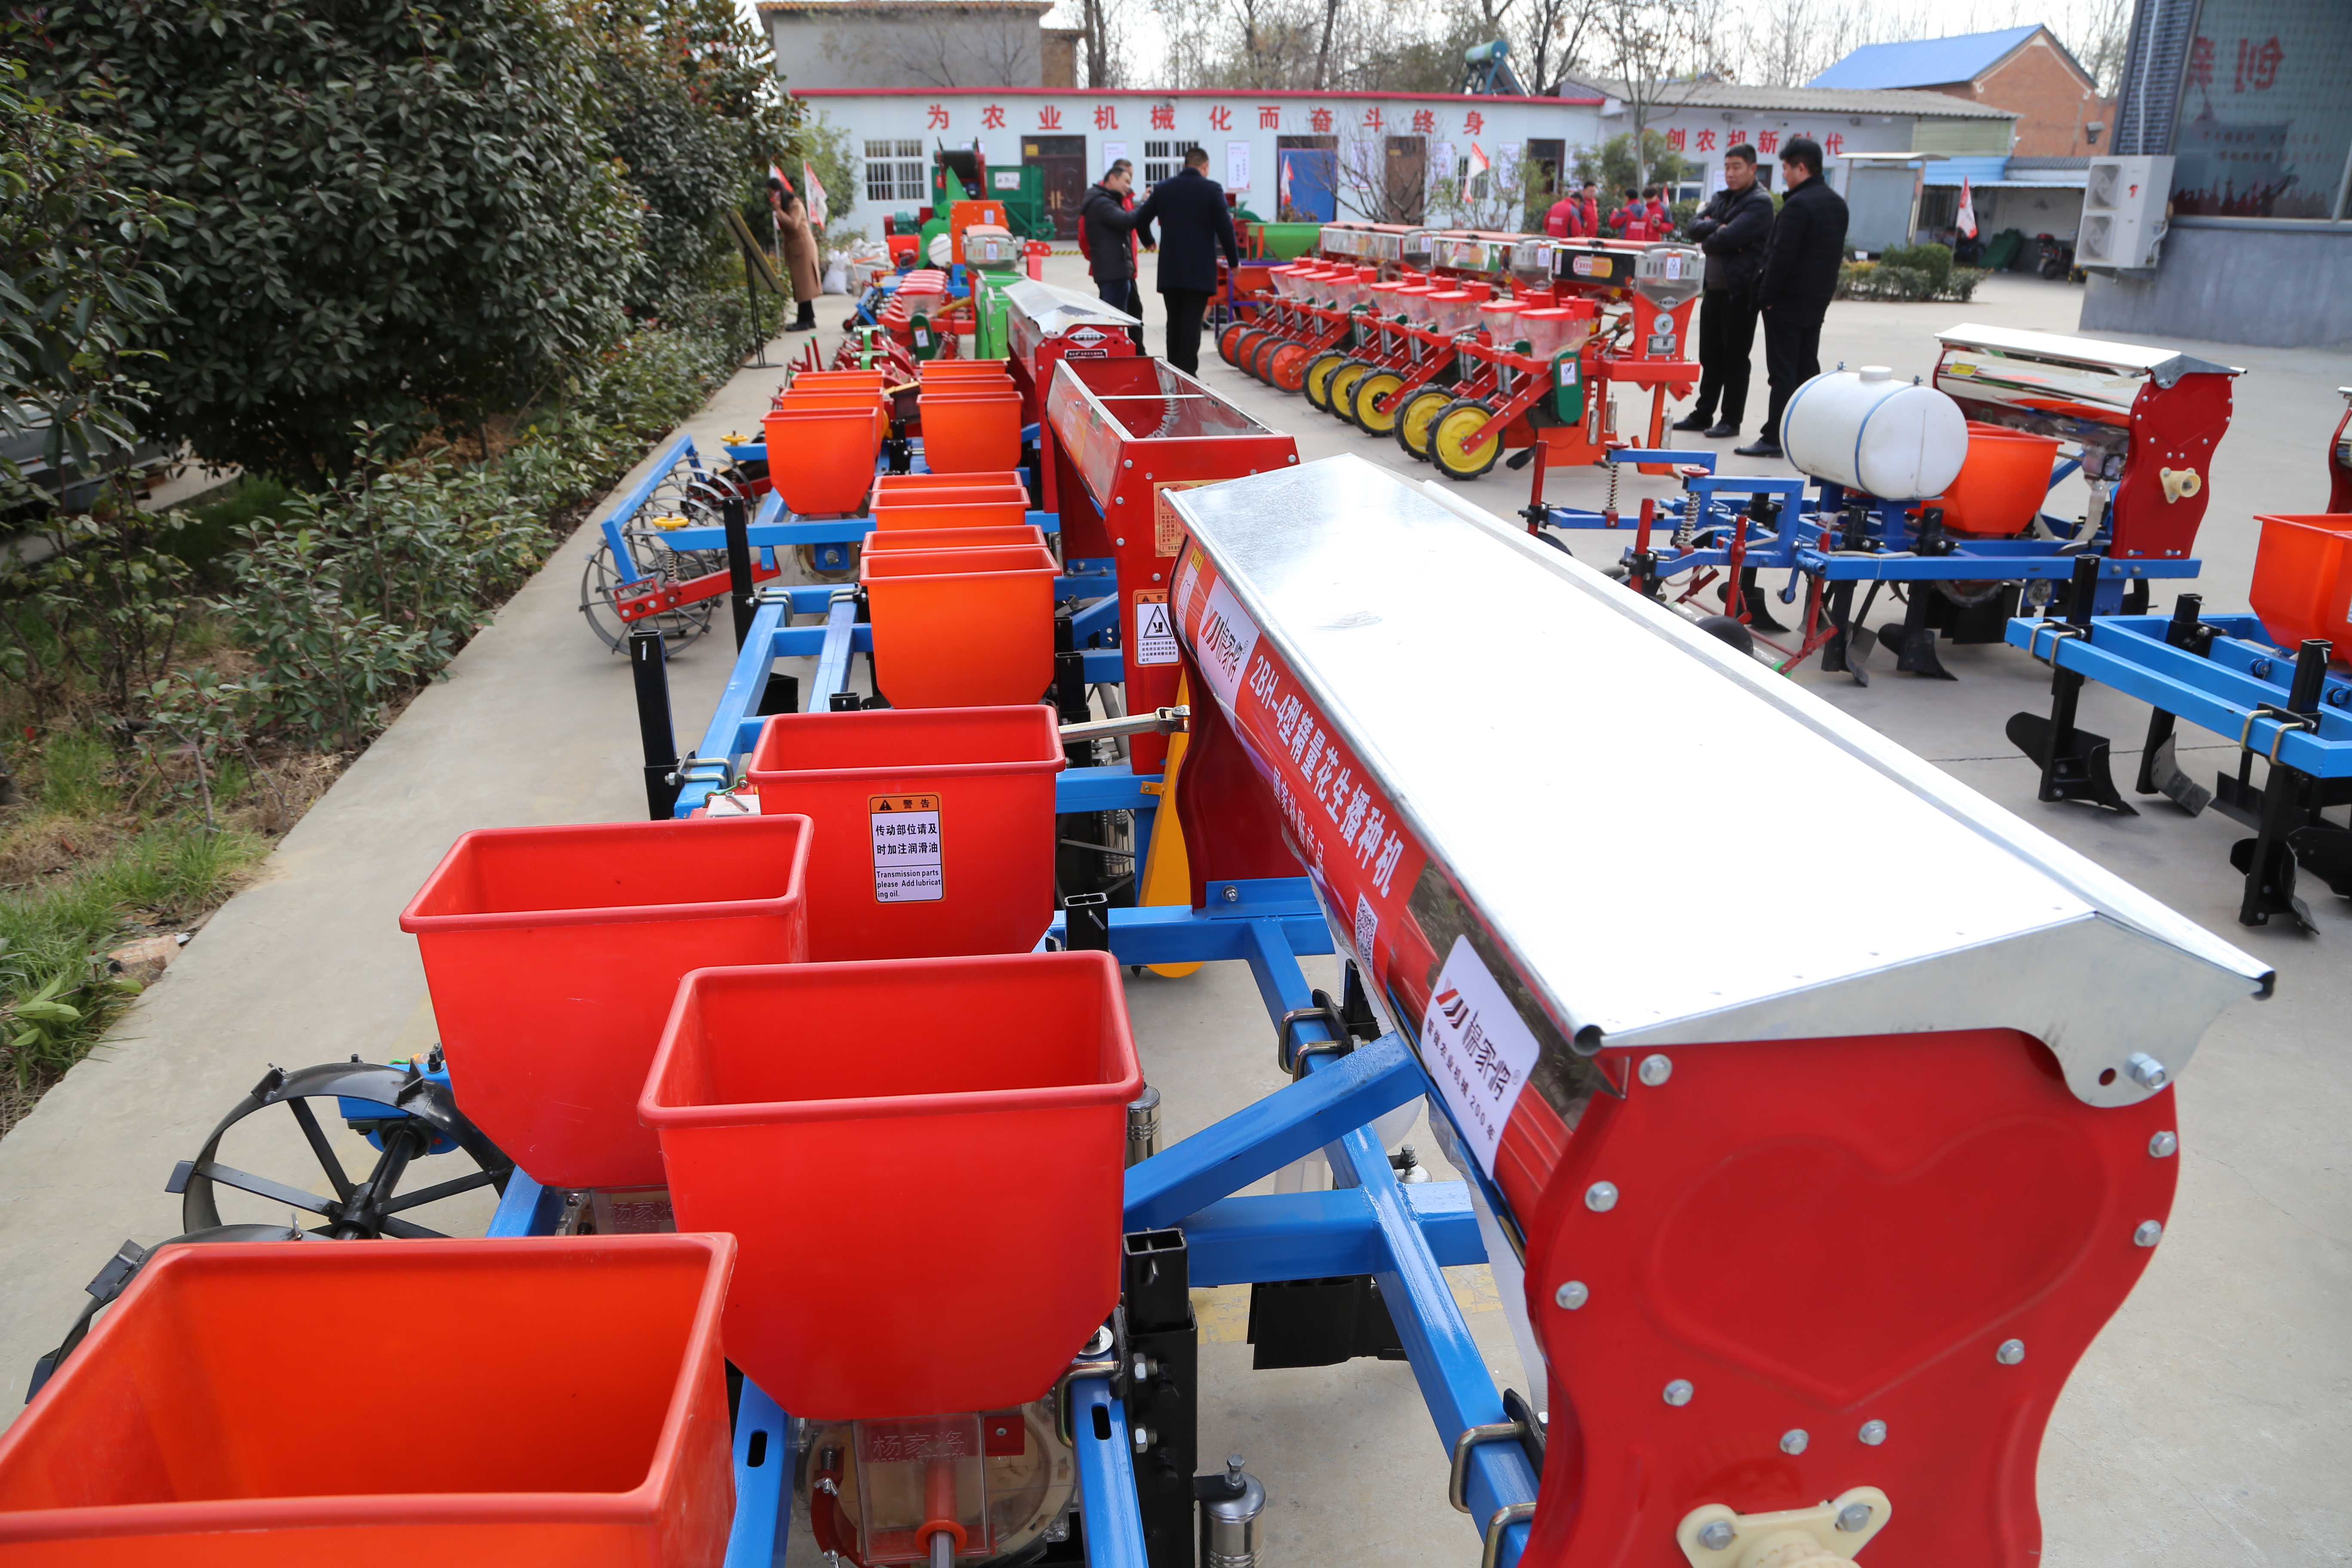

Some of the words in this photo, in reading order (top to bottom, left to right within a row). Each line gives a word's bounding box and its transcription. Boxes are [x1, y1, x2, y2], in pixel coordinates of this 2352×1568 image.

[927, 104, 1484, 135] 为农业机械化而奋斗终身
[1632, 127, 1844, 156] 创农机新代
[1249, 655, 1404, 898] 2BH-4型精量花生播种机
[903, 799, 930, 809] 警告
[1273, 764, 1324, 881] 国家补贴产品
[876, 823, 937, 836] 传动部位请及
[877, 842, 938, 855] 时加注润滑油
[876, 870, 920, 878] Transmission
[922, 870, 939, 878] parts
[877, 881, 898, 889] please
[878, 891, 888, 899] ing
[873, 1430, 964, 1457] 杨家将
